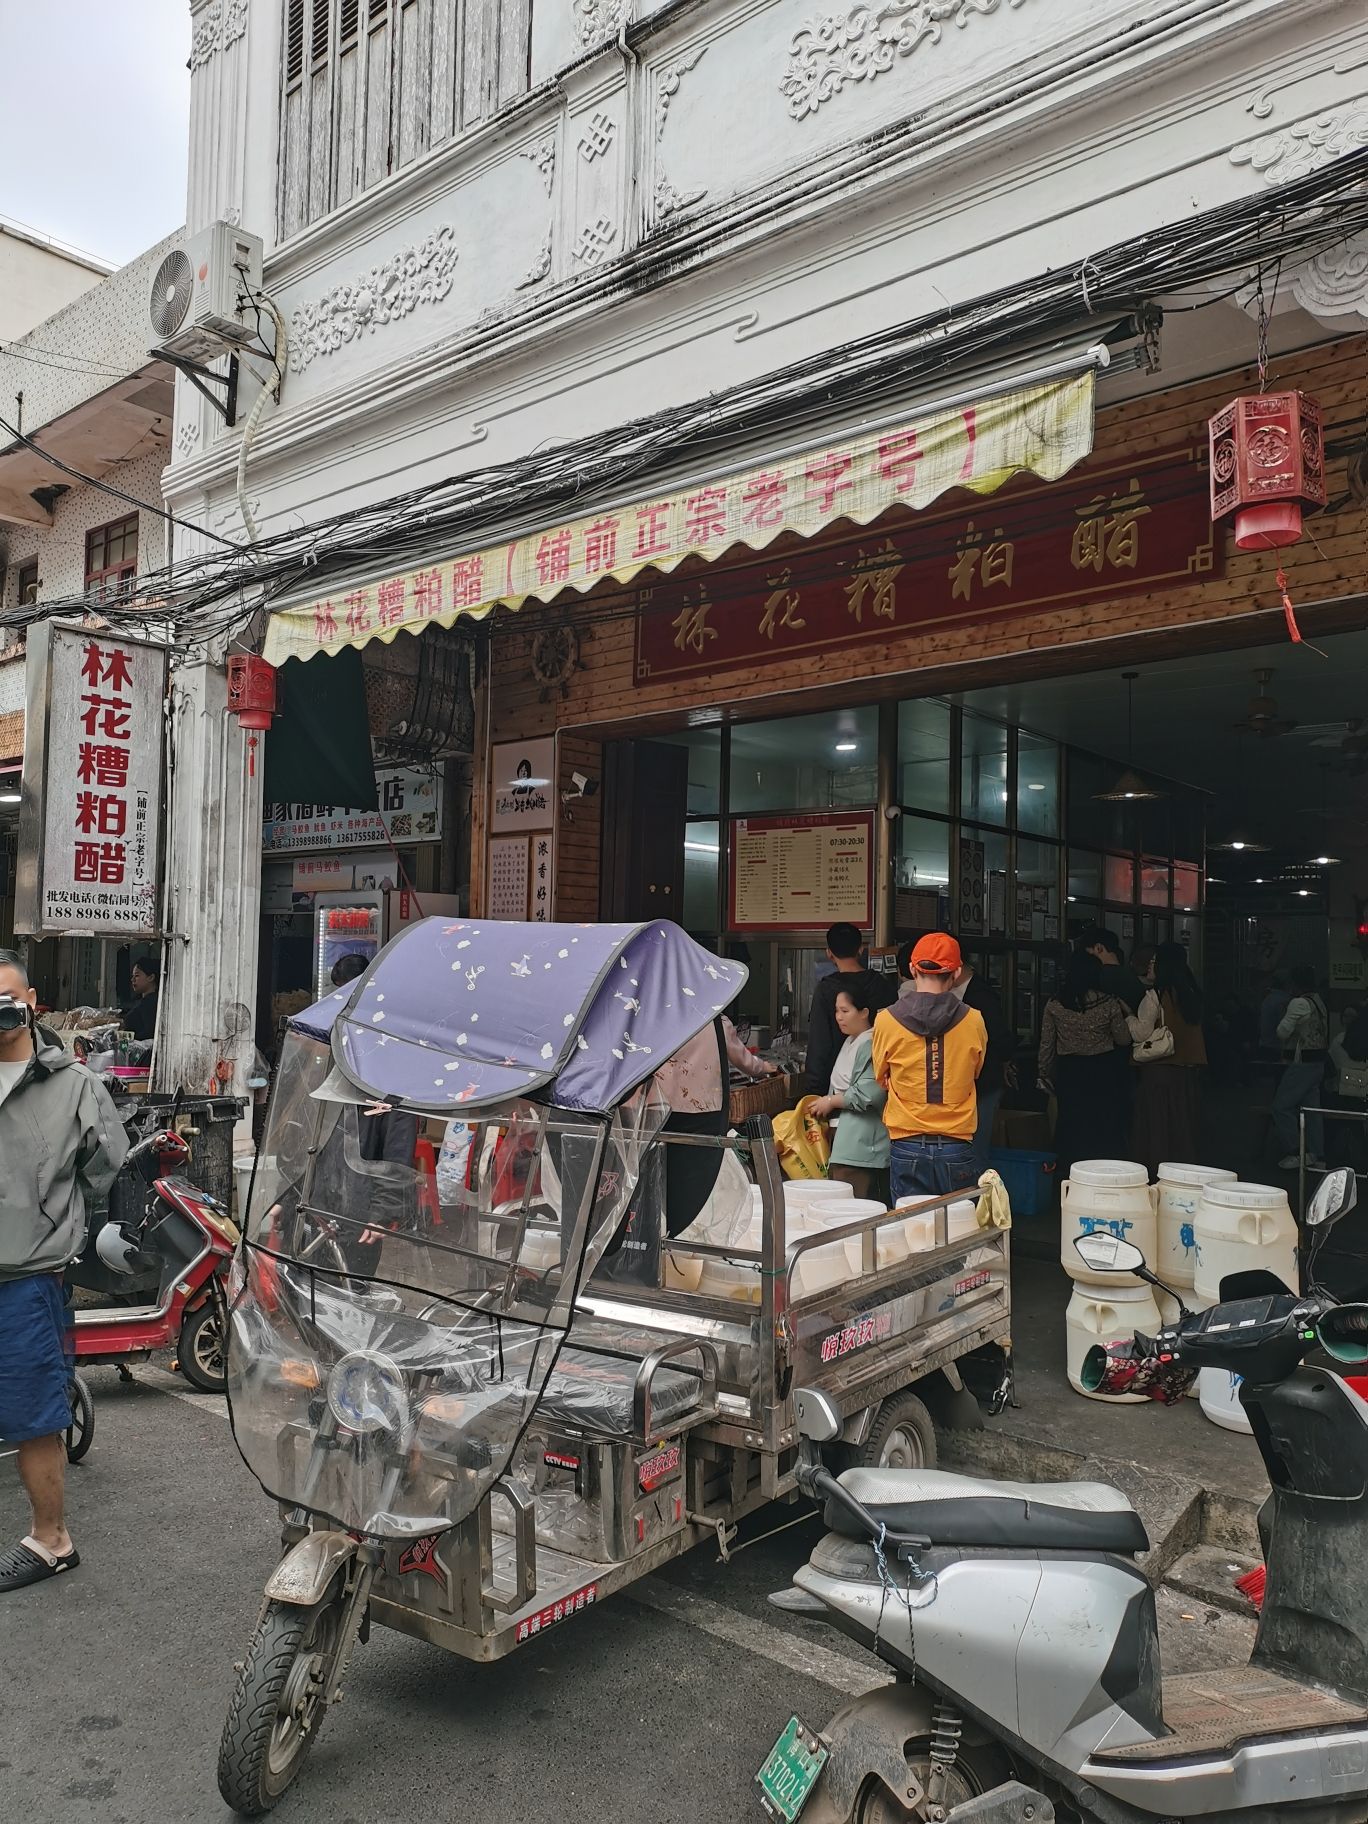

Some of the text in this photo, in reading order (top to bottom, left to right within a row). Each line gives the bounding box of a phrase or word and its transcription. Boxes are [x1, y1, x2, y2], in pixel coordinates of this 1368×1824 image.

[671, 477, 1152, 655] 林花糟粕醋
[74, 643, 133, 885] 林花糟粕醋
[336, 830, 385, 844] 13617555826
[829, 837, 865, 847] 07:30-20:30
[46, 906, 147, 921] 188 8986 8887
[519, 1586, 595, 1641] 高端三轮制造者
